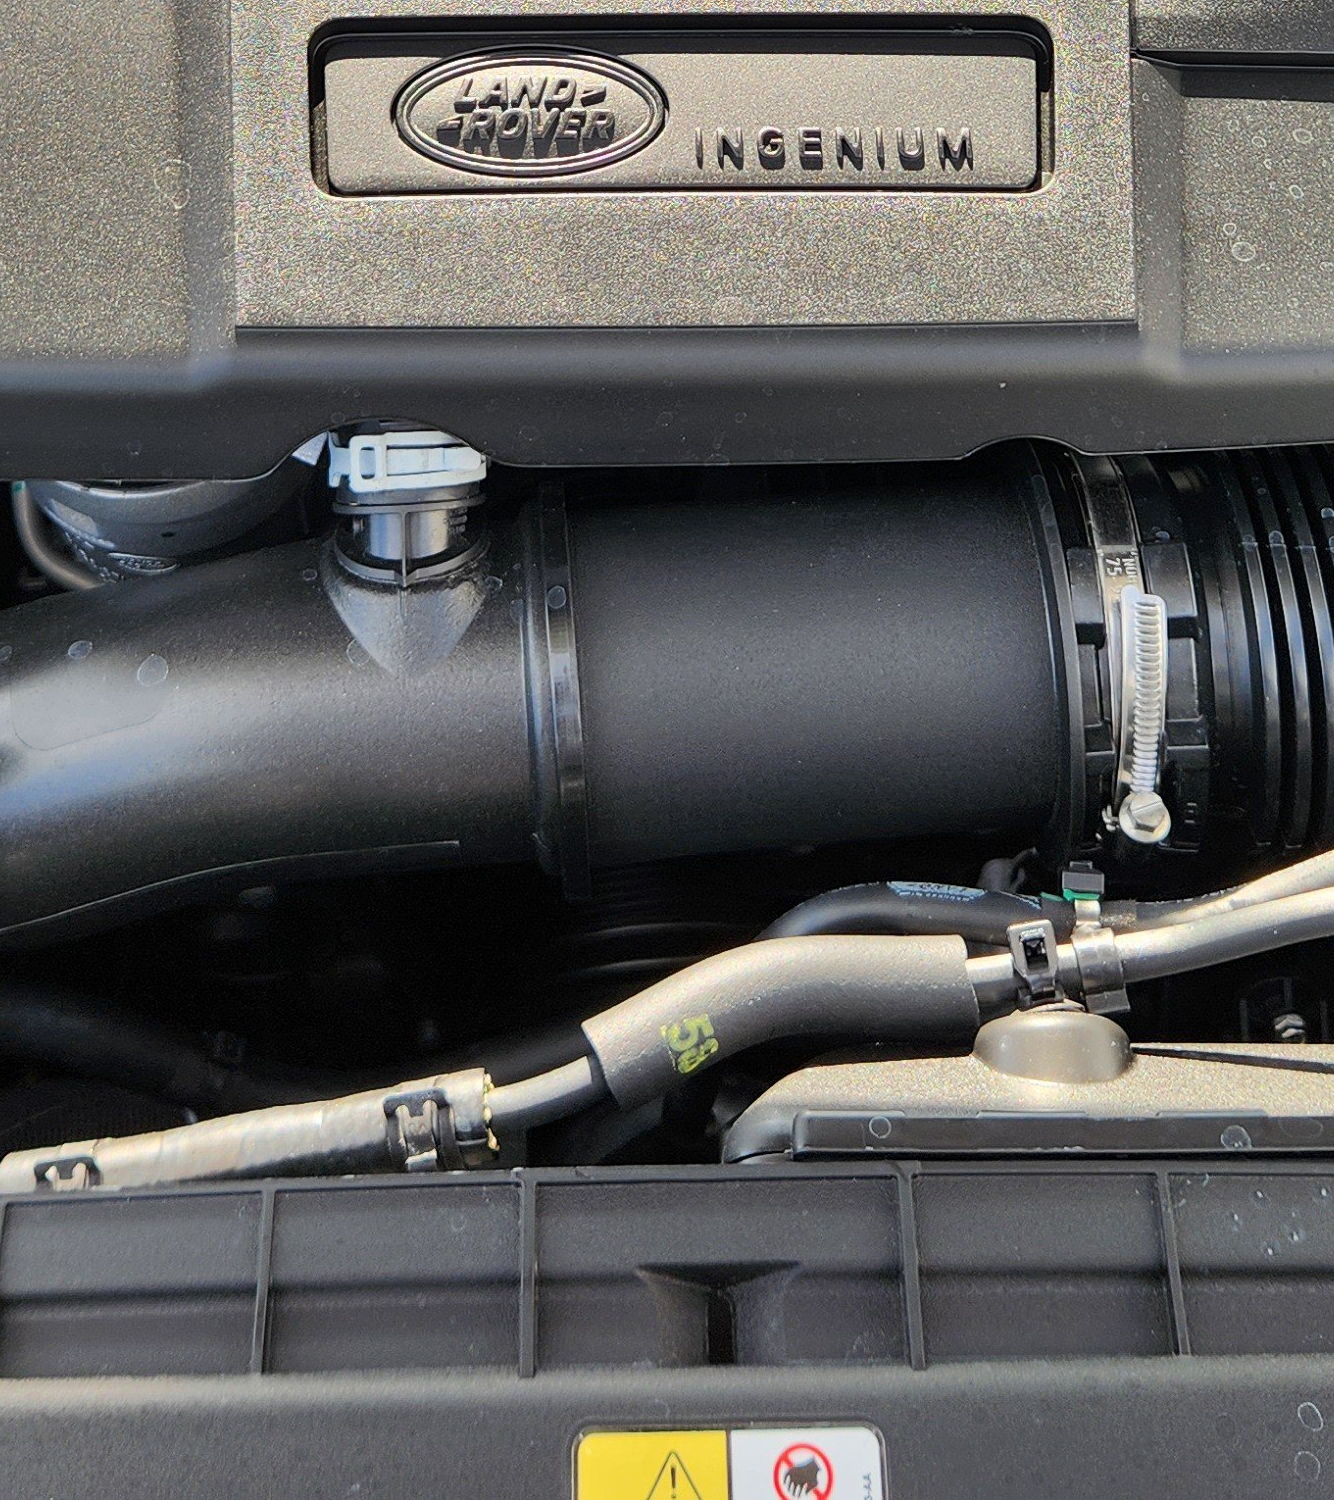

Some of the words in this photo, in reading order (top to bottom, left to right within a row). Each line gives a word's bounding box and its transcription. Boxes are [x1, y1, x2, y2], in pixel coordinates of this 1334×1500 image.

[454, 77, 580, 112] LAND
[464, 108, 617, 148] ROVER
[694, 126, 976, 171] INGENIUM
